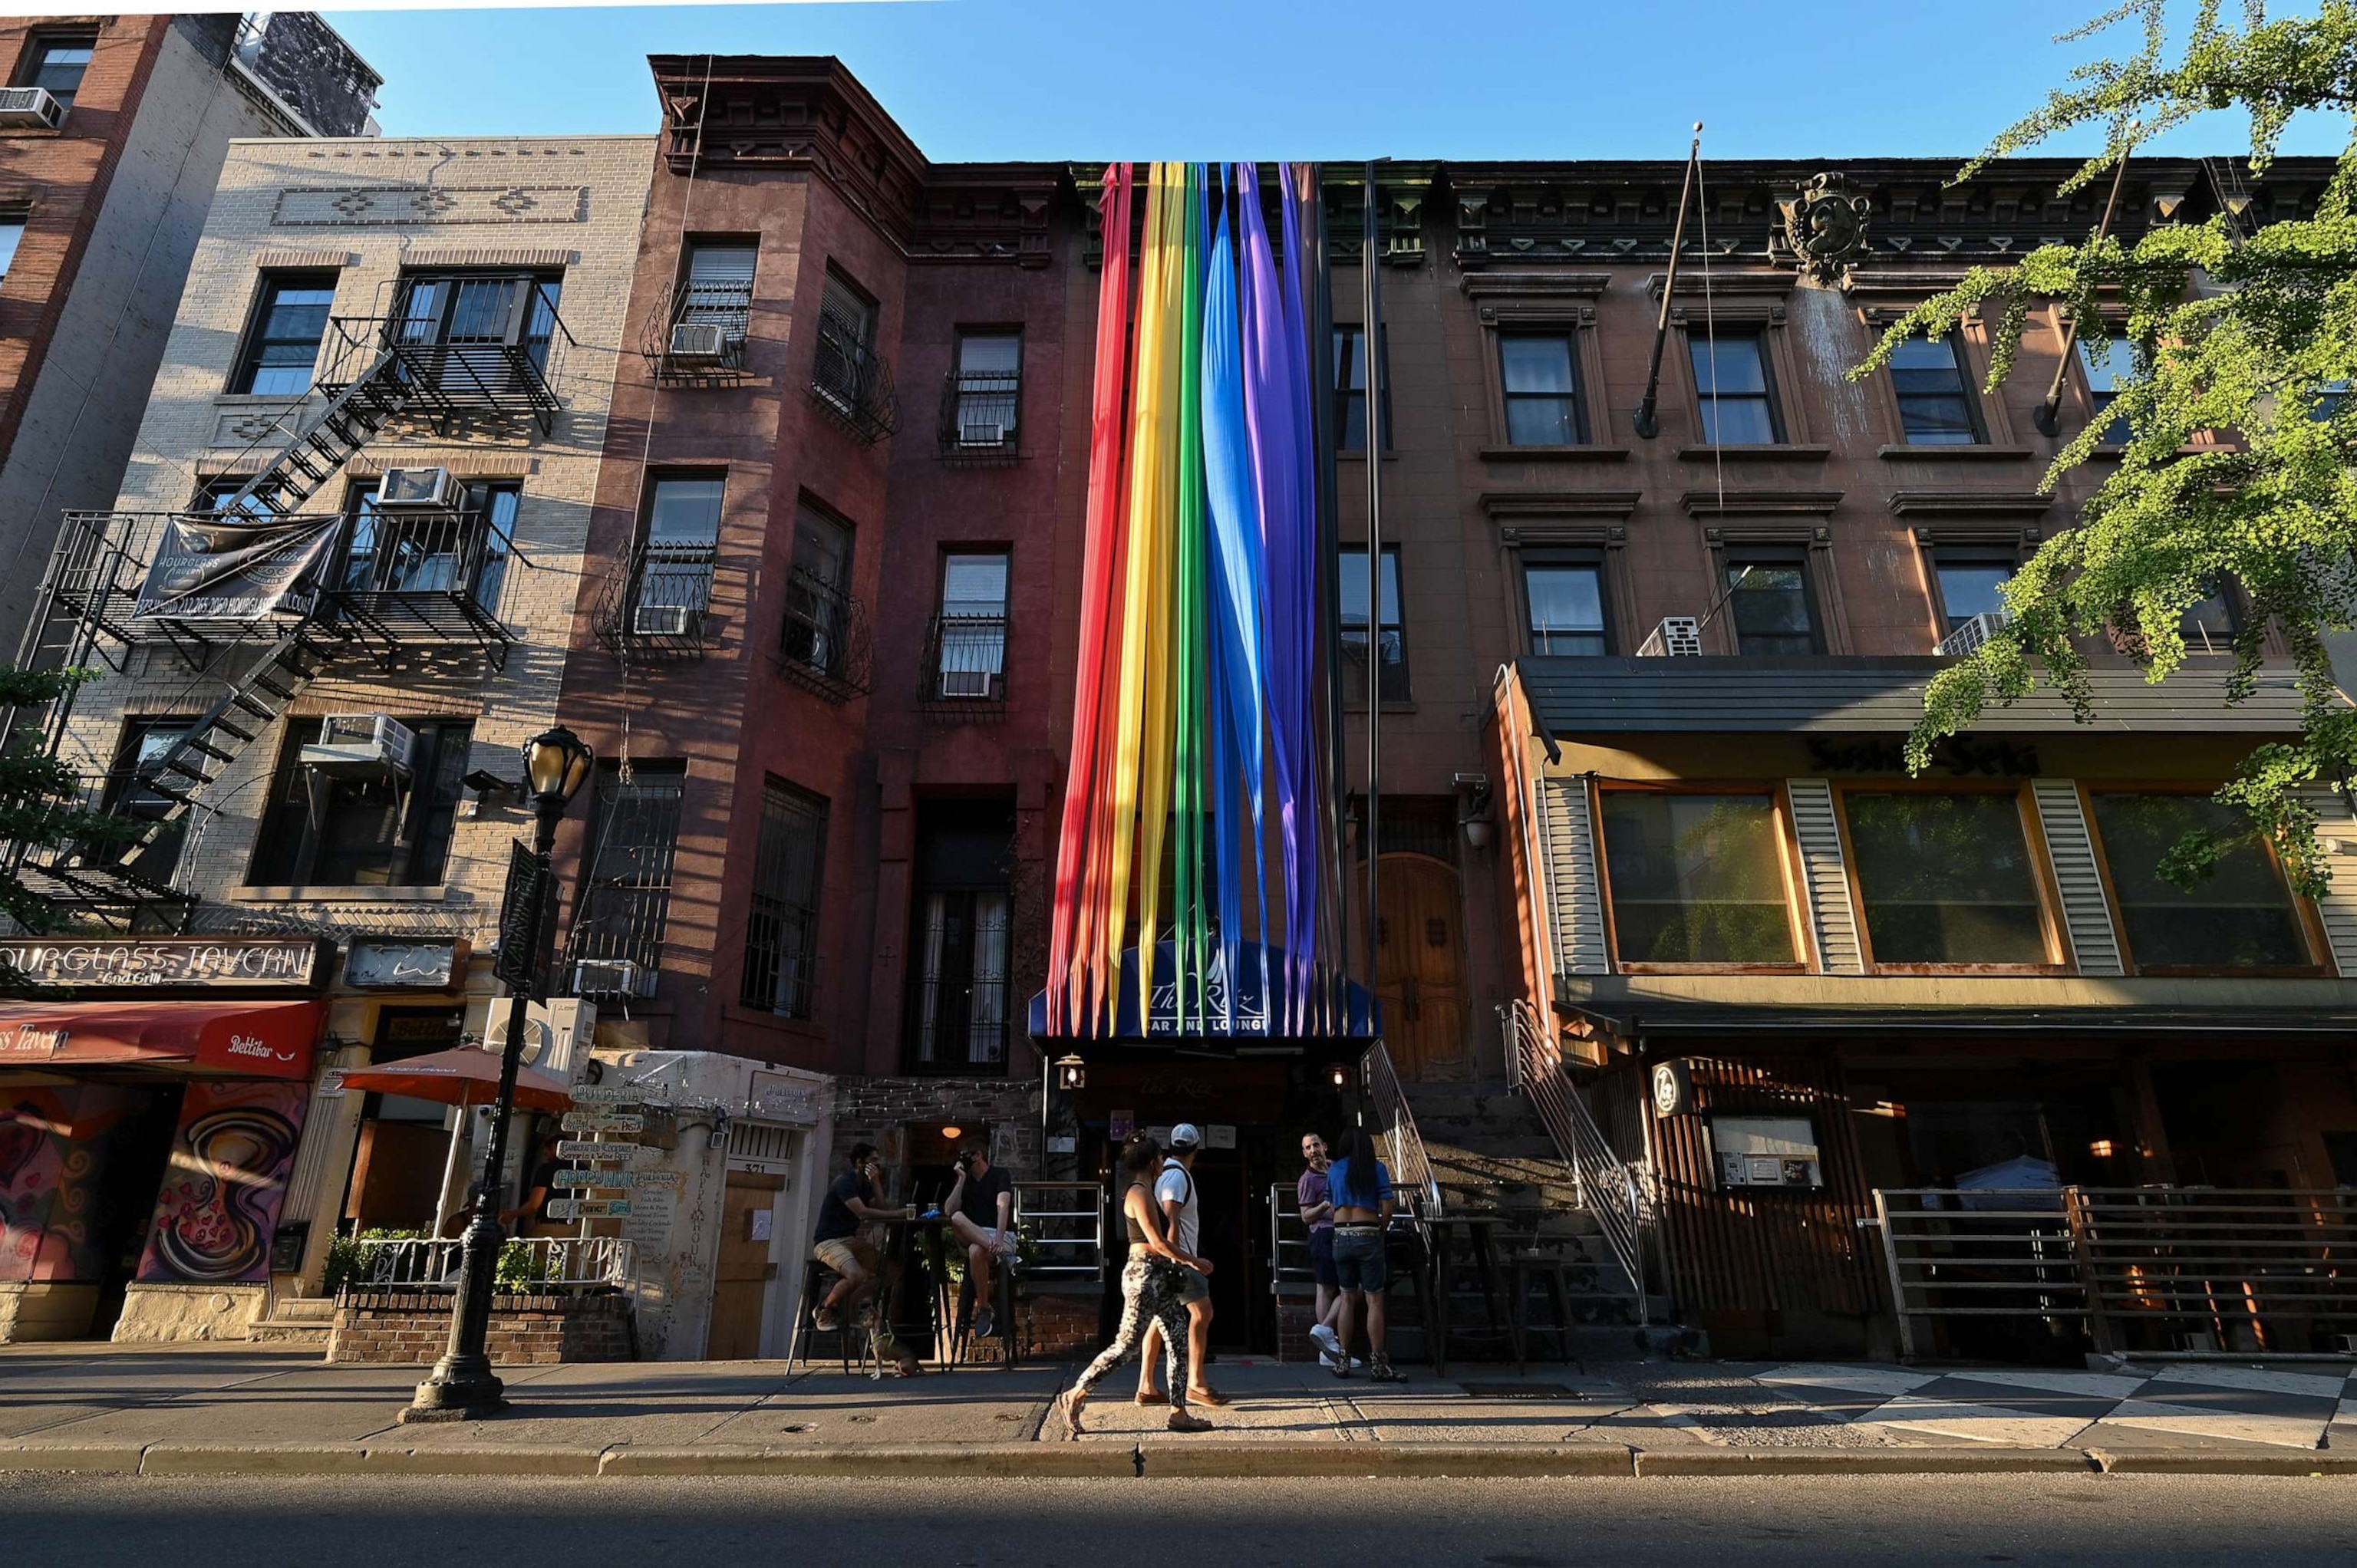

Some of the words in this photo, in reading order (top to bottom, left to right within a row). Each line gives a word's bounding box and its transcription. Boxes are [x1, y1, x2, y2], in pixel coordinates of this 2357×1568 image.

[158, 557, 219, 568] HOURGLASS
[228, 1034, 273, 1057] Bettibar
[746, 1163, 765, 1174] 371
